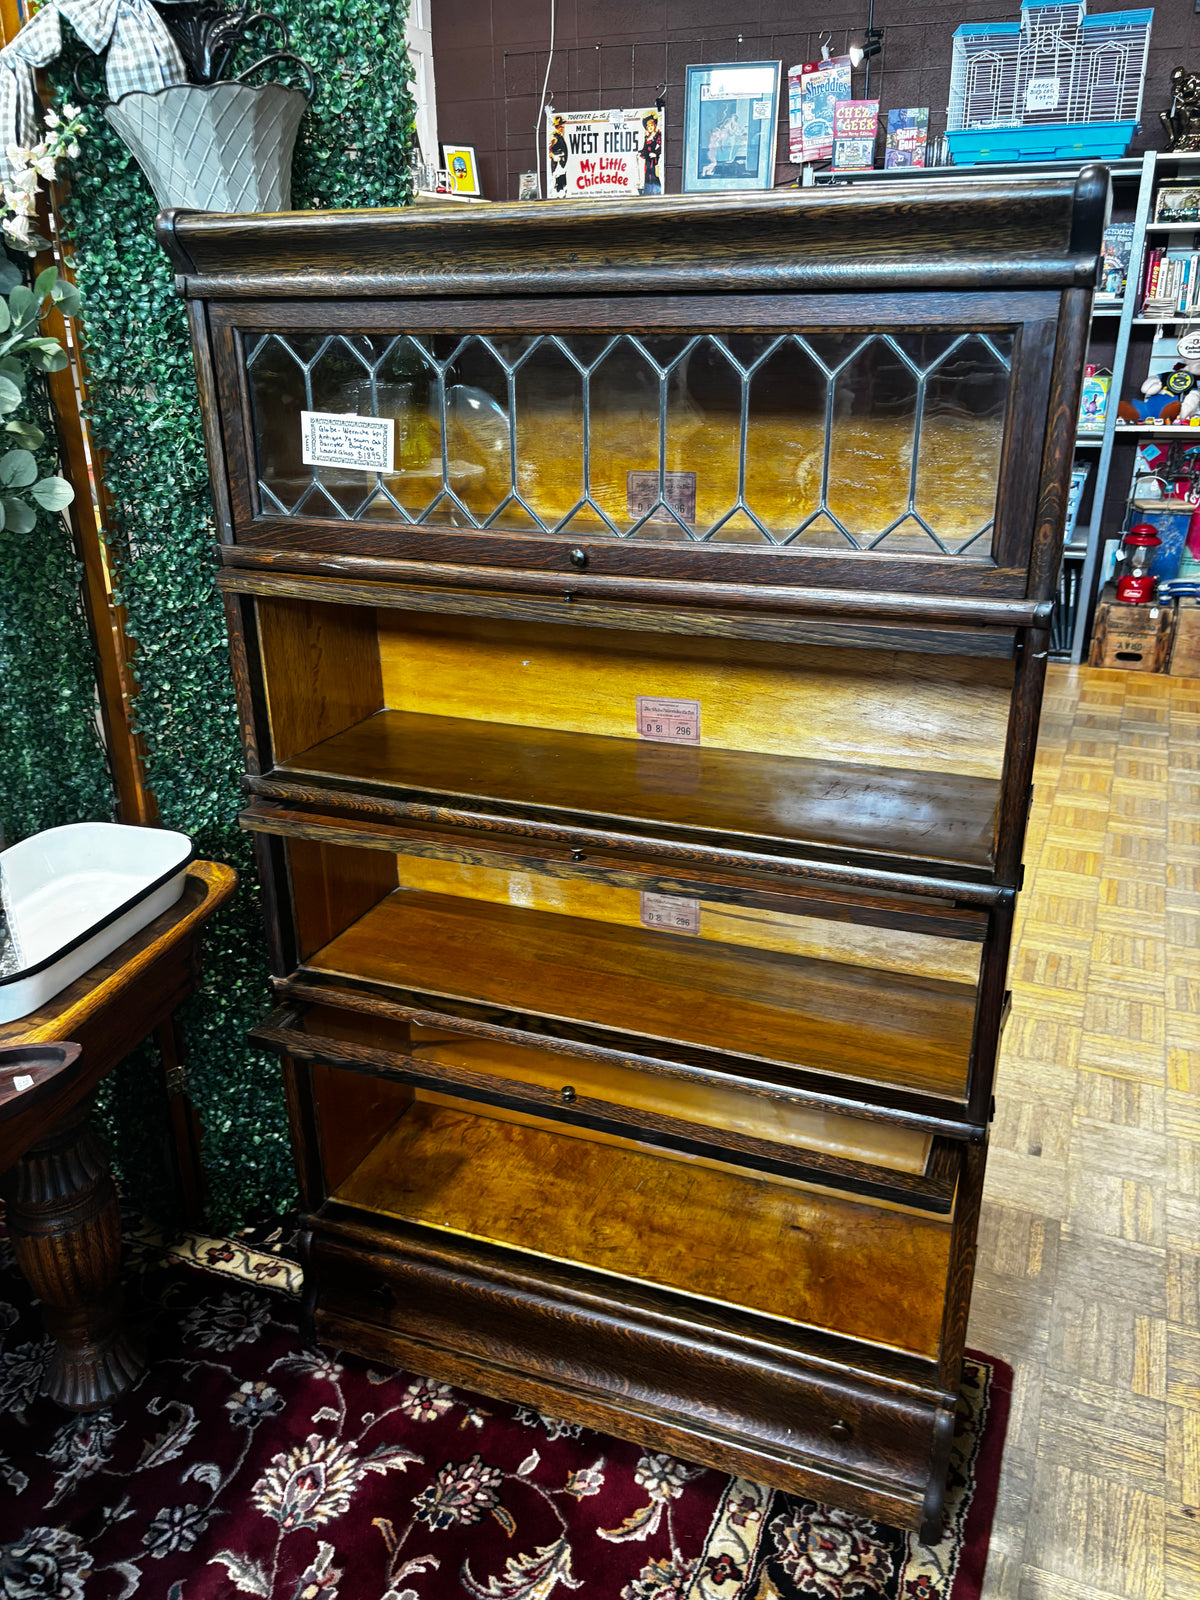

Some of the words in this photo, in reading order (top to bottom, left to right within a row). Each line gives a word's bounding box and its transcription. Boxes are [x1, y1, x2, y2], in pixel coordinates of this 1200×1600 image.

[806, 78, 848, 100] Shreddies
[836, 105, 870, 118] CHEZ
[842, 118, 876, 131] GEEK
[569, 133, 599, 155] WEST
[604, 131, 639, 153] FIELDS
[898, 140, 917, 151] GOAT
[580, 159, 596, 174] My
[600, 157, 627, 172] Little
[576, 172, 629, 190] Chickadee
[338, 449, 354, 457] Glass
[357, 450, 381, 460] $1895
[646, 723, 652, 732] D
[676, 726, 691, 736] 296
[648, 912, 654, 920] D
[676, 917, 690, 927] 296
